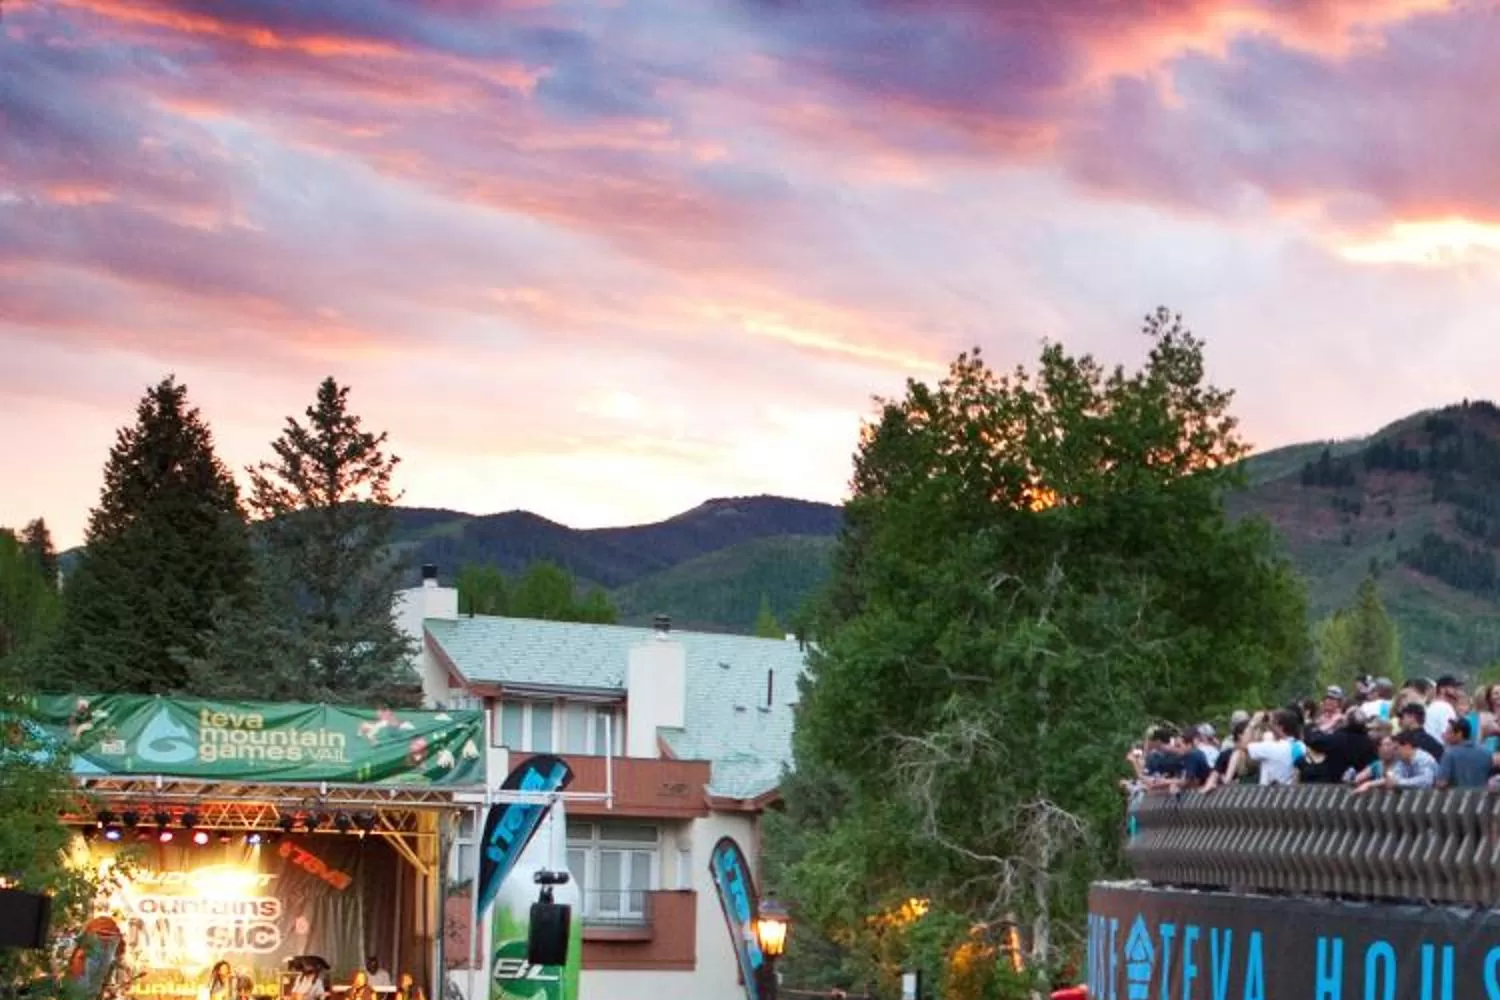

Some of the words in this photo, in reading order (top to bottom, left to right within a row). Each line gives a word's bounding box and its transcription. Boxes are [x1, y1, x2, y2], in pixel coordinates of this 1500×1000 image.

[201, 708, 263, 728] teva
[201, 727, 346, 748] mountain
[201, 743, 301, 763] games
